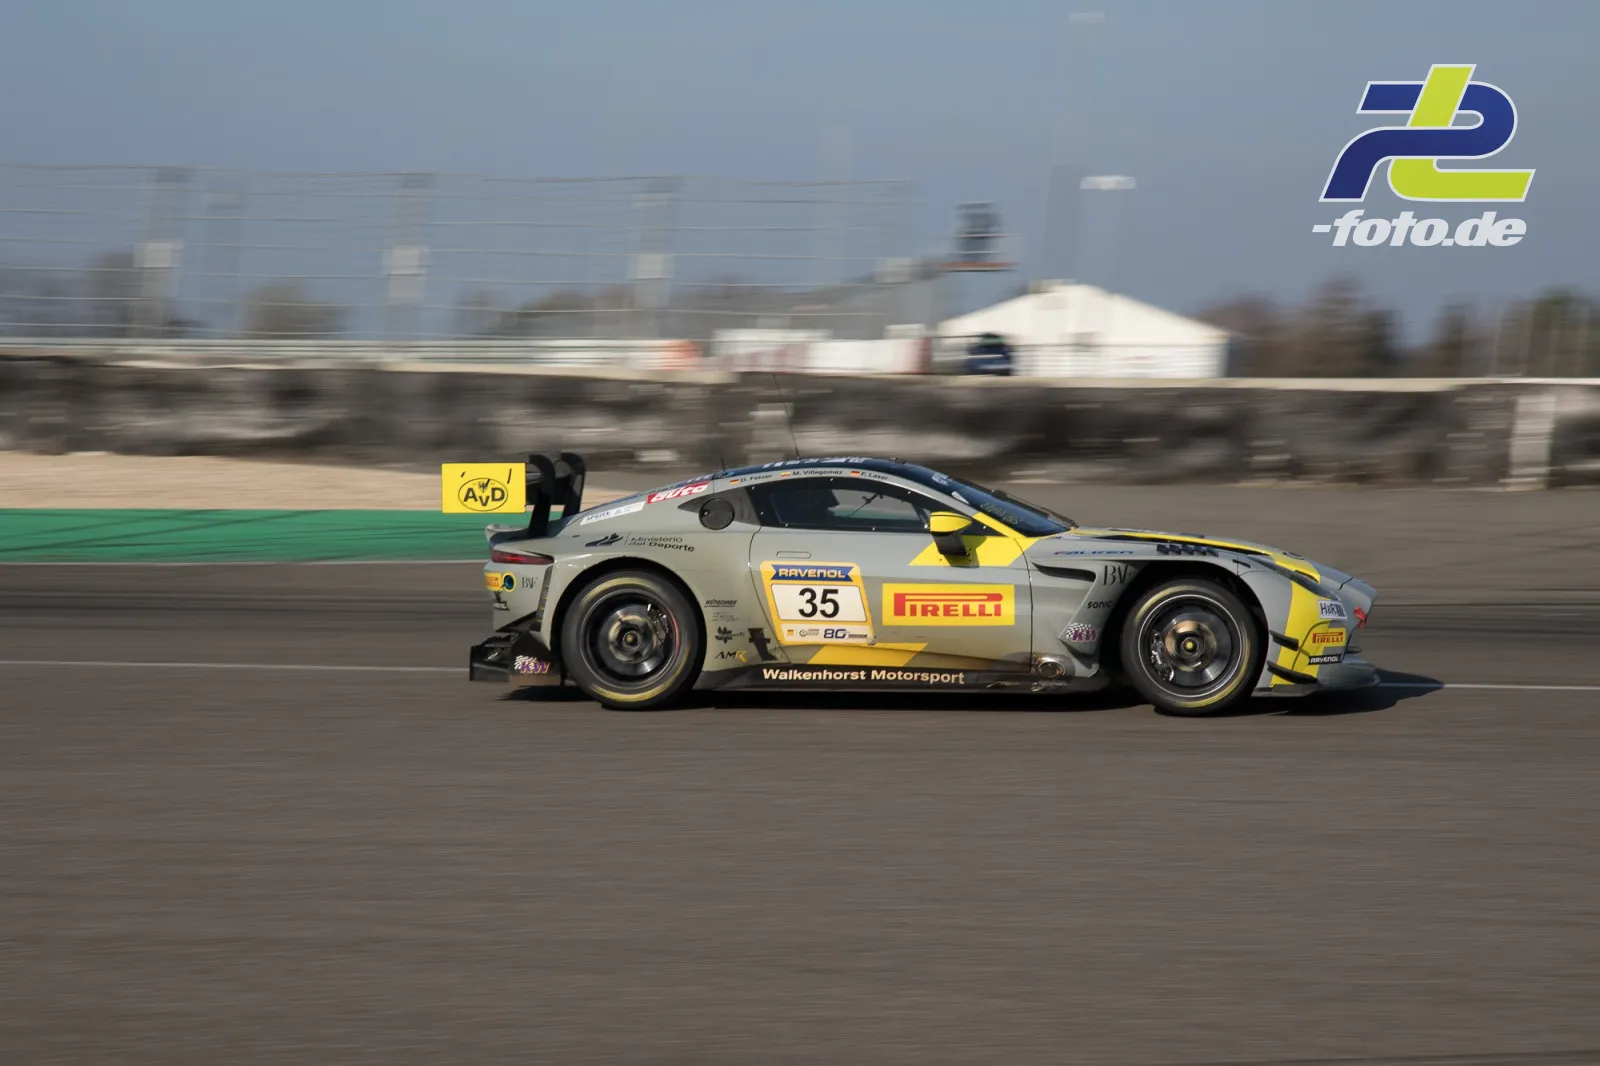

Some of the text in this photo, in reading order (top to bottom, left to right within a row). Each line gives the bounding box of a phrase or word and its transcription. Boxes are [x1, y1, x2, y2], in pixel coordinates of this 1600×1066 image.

[630, 536, 684, 544] Ministerio
[648, 541, 695, 552] Deporte
[778, 568, 847, 579] RAVENOL
[798, 587, 840, 619] 35
[893, 592, 1003, 617] PIRELLI
[1087, 600, 1113, 609] sonic
[1312, 631, 1343, 643] PIRELLI
[1310, 655, 1339, 663] RAVENOL
[762, 668, 965, 685] Walkenhorst Motorsport
